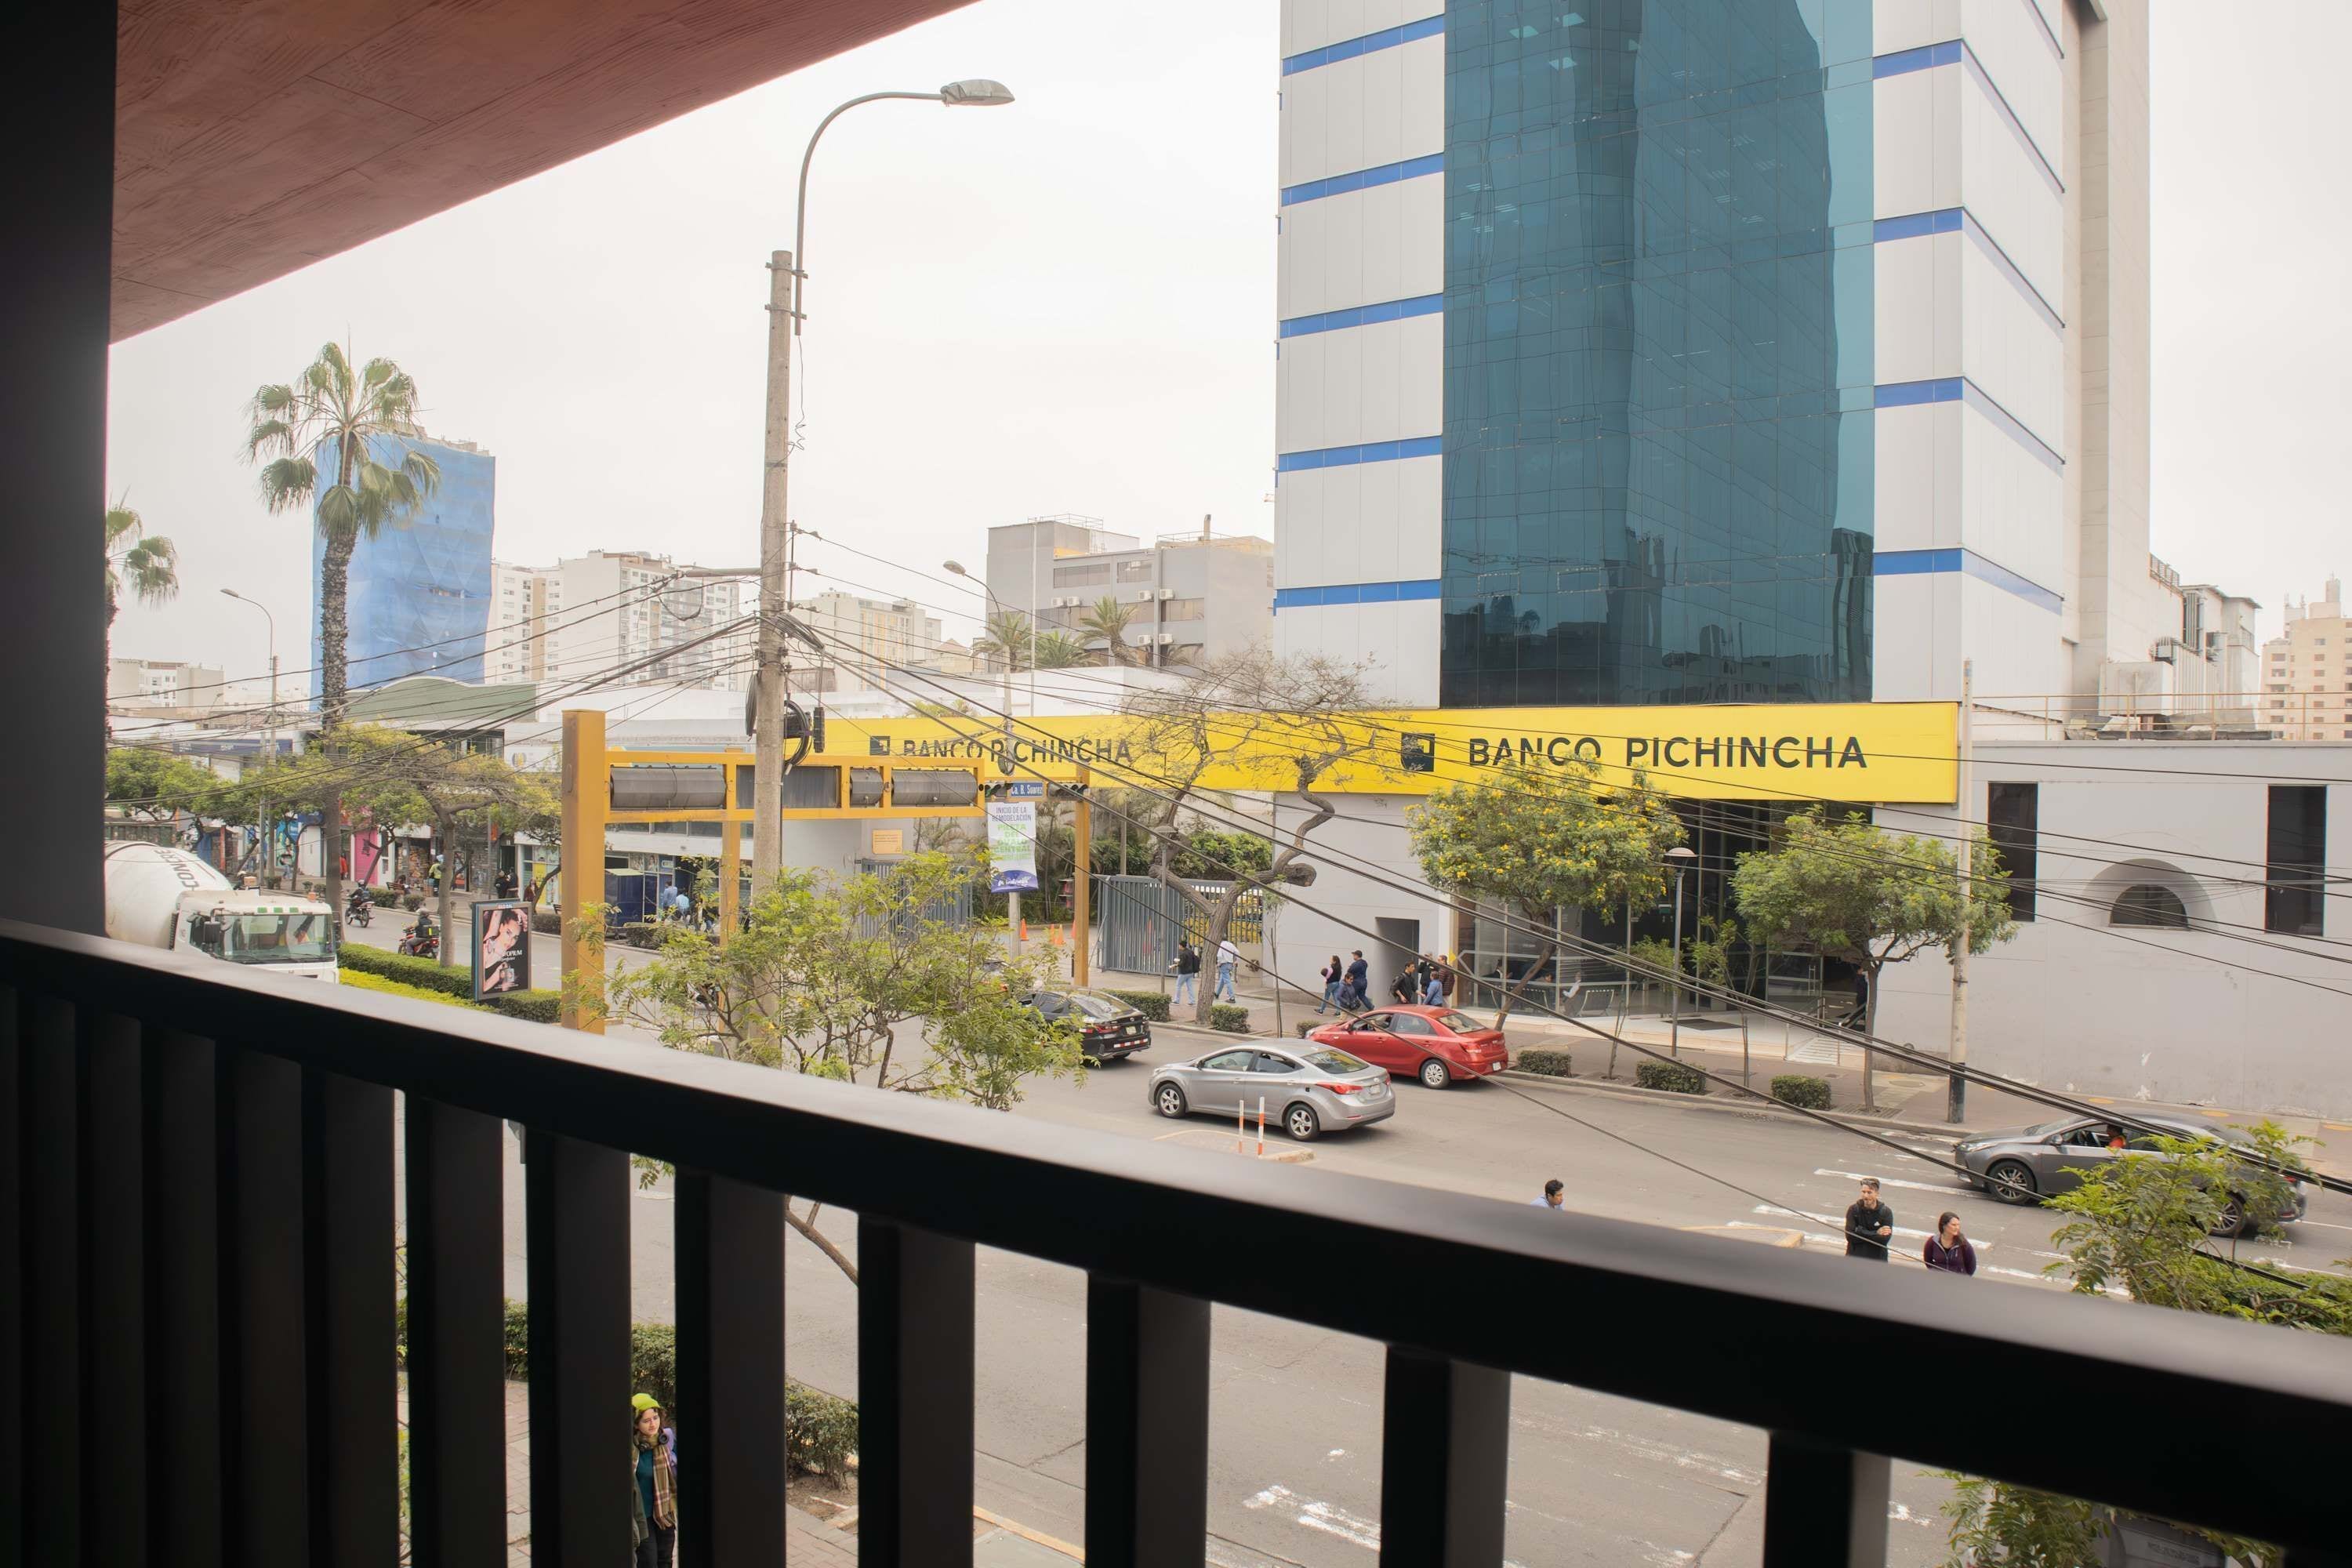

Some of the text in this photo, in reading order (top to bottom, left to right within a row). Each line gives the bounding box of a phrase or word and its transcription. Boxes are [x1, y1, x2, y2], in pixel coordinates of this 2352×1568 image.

[903, 739, 1134, 763] BANCO PCHINCHA
[1469, 736, 1868, 768] BANCO PICHINCHA
